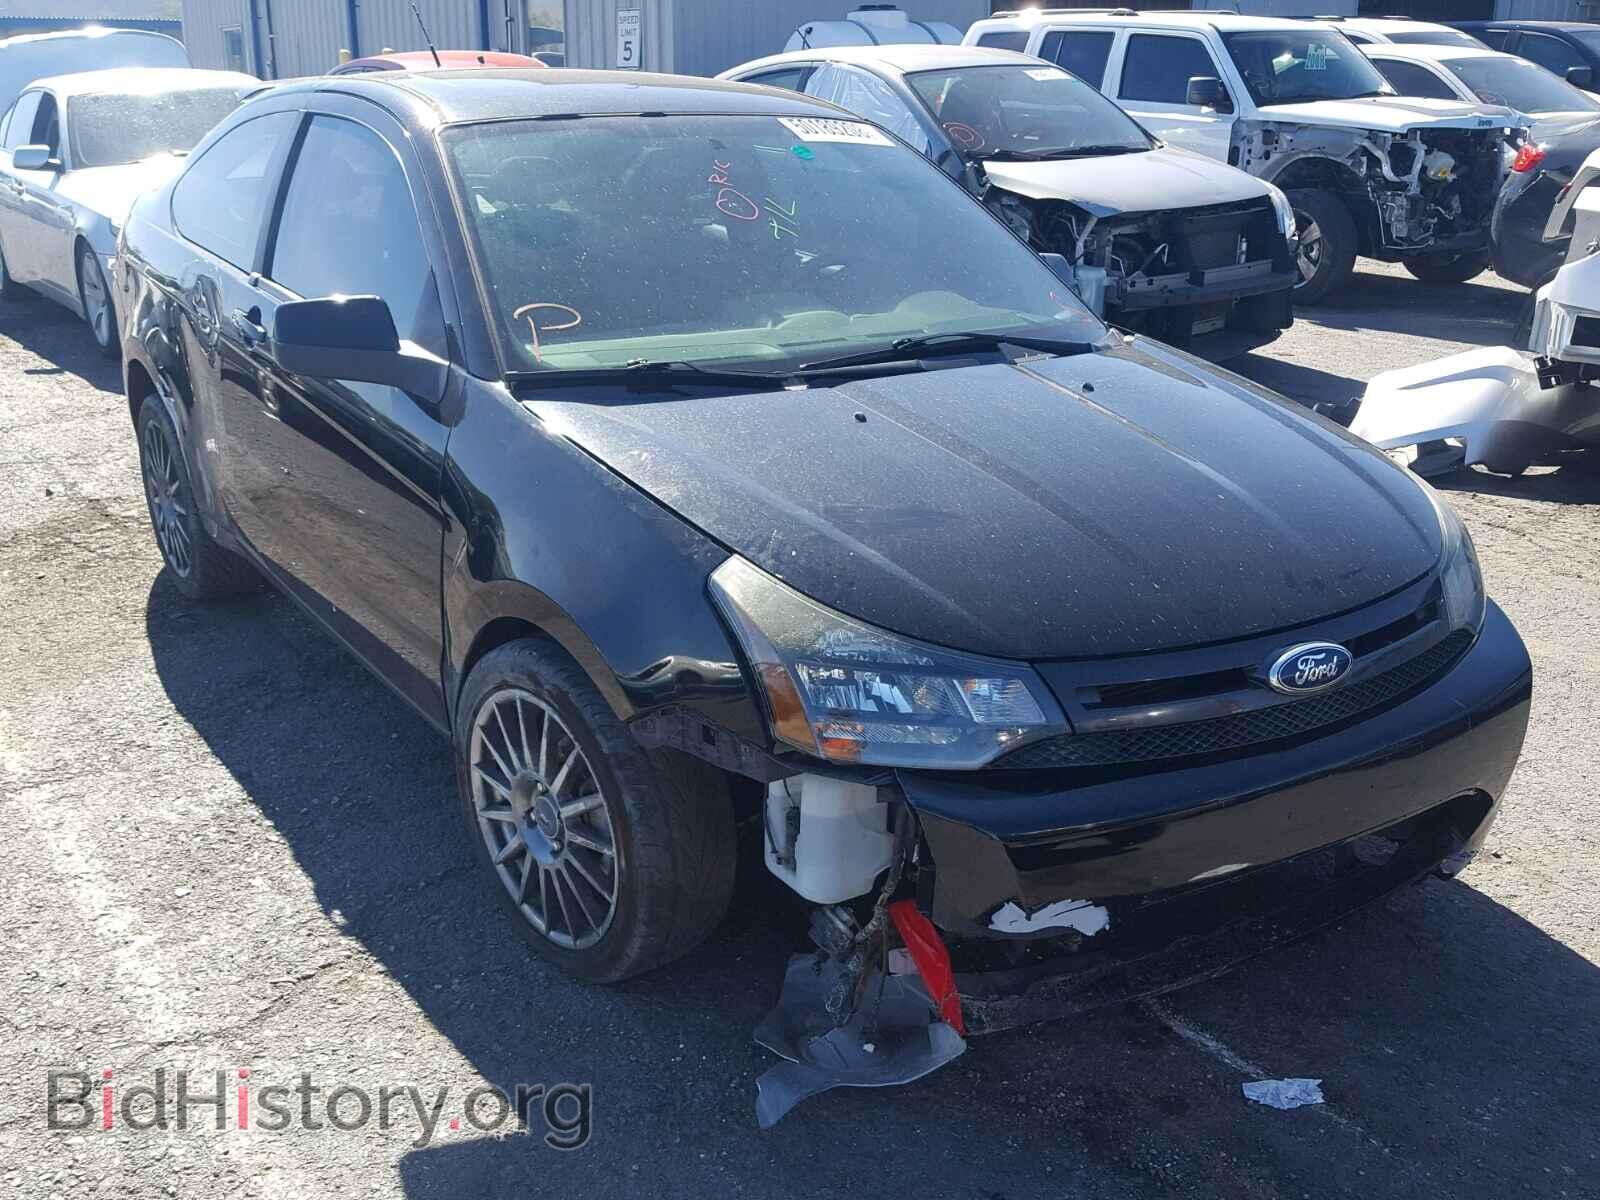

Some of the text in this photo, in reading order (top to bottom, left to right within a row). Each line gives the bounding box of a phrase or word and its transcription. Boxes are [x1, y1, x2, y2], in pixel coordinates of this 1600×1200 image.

[618, 15, 639, 24] SPEED
[620, 27, 638, 37] LIMIT
[623, 41, 632, 61] 5
[1295, 653, 1338, 685] Ford
